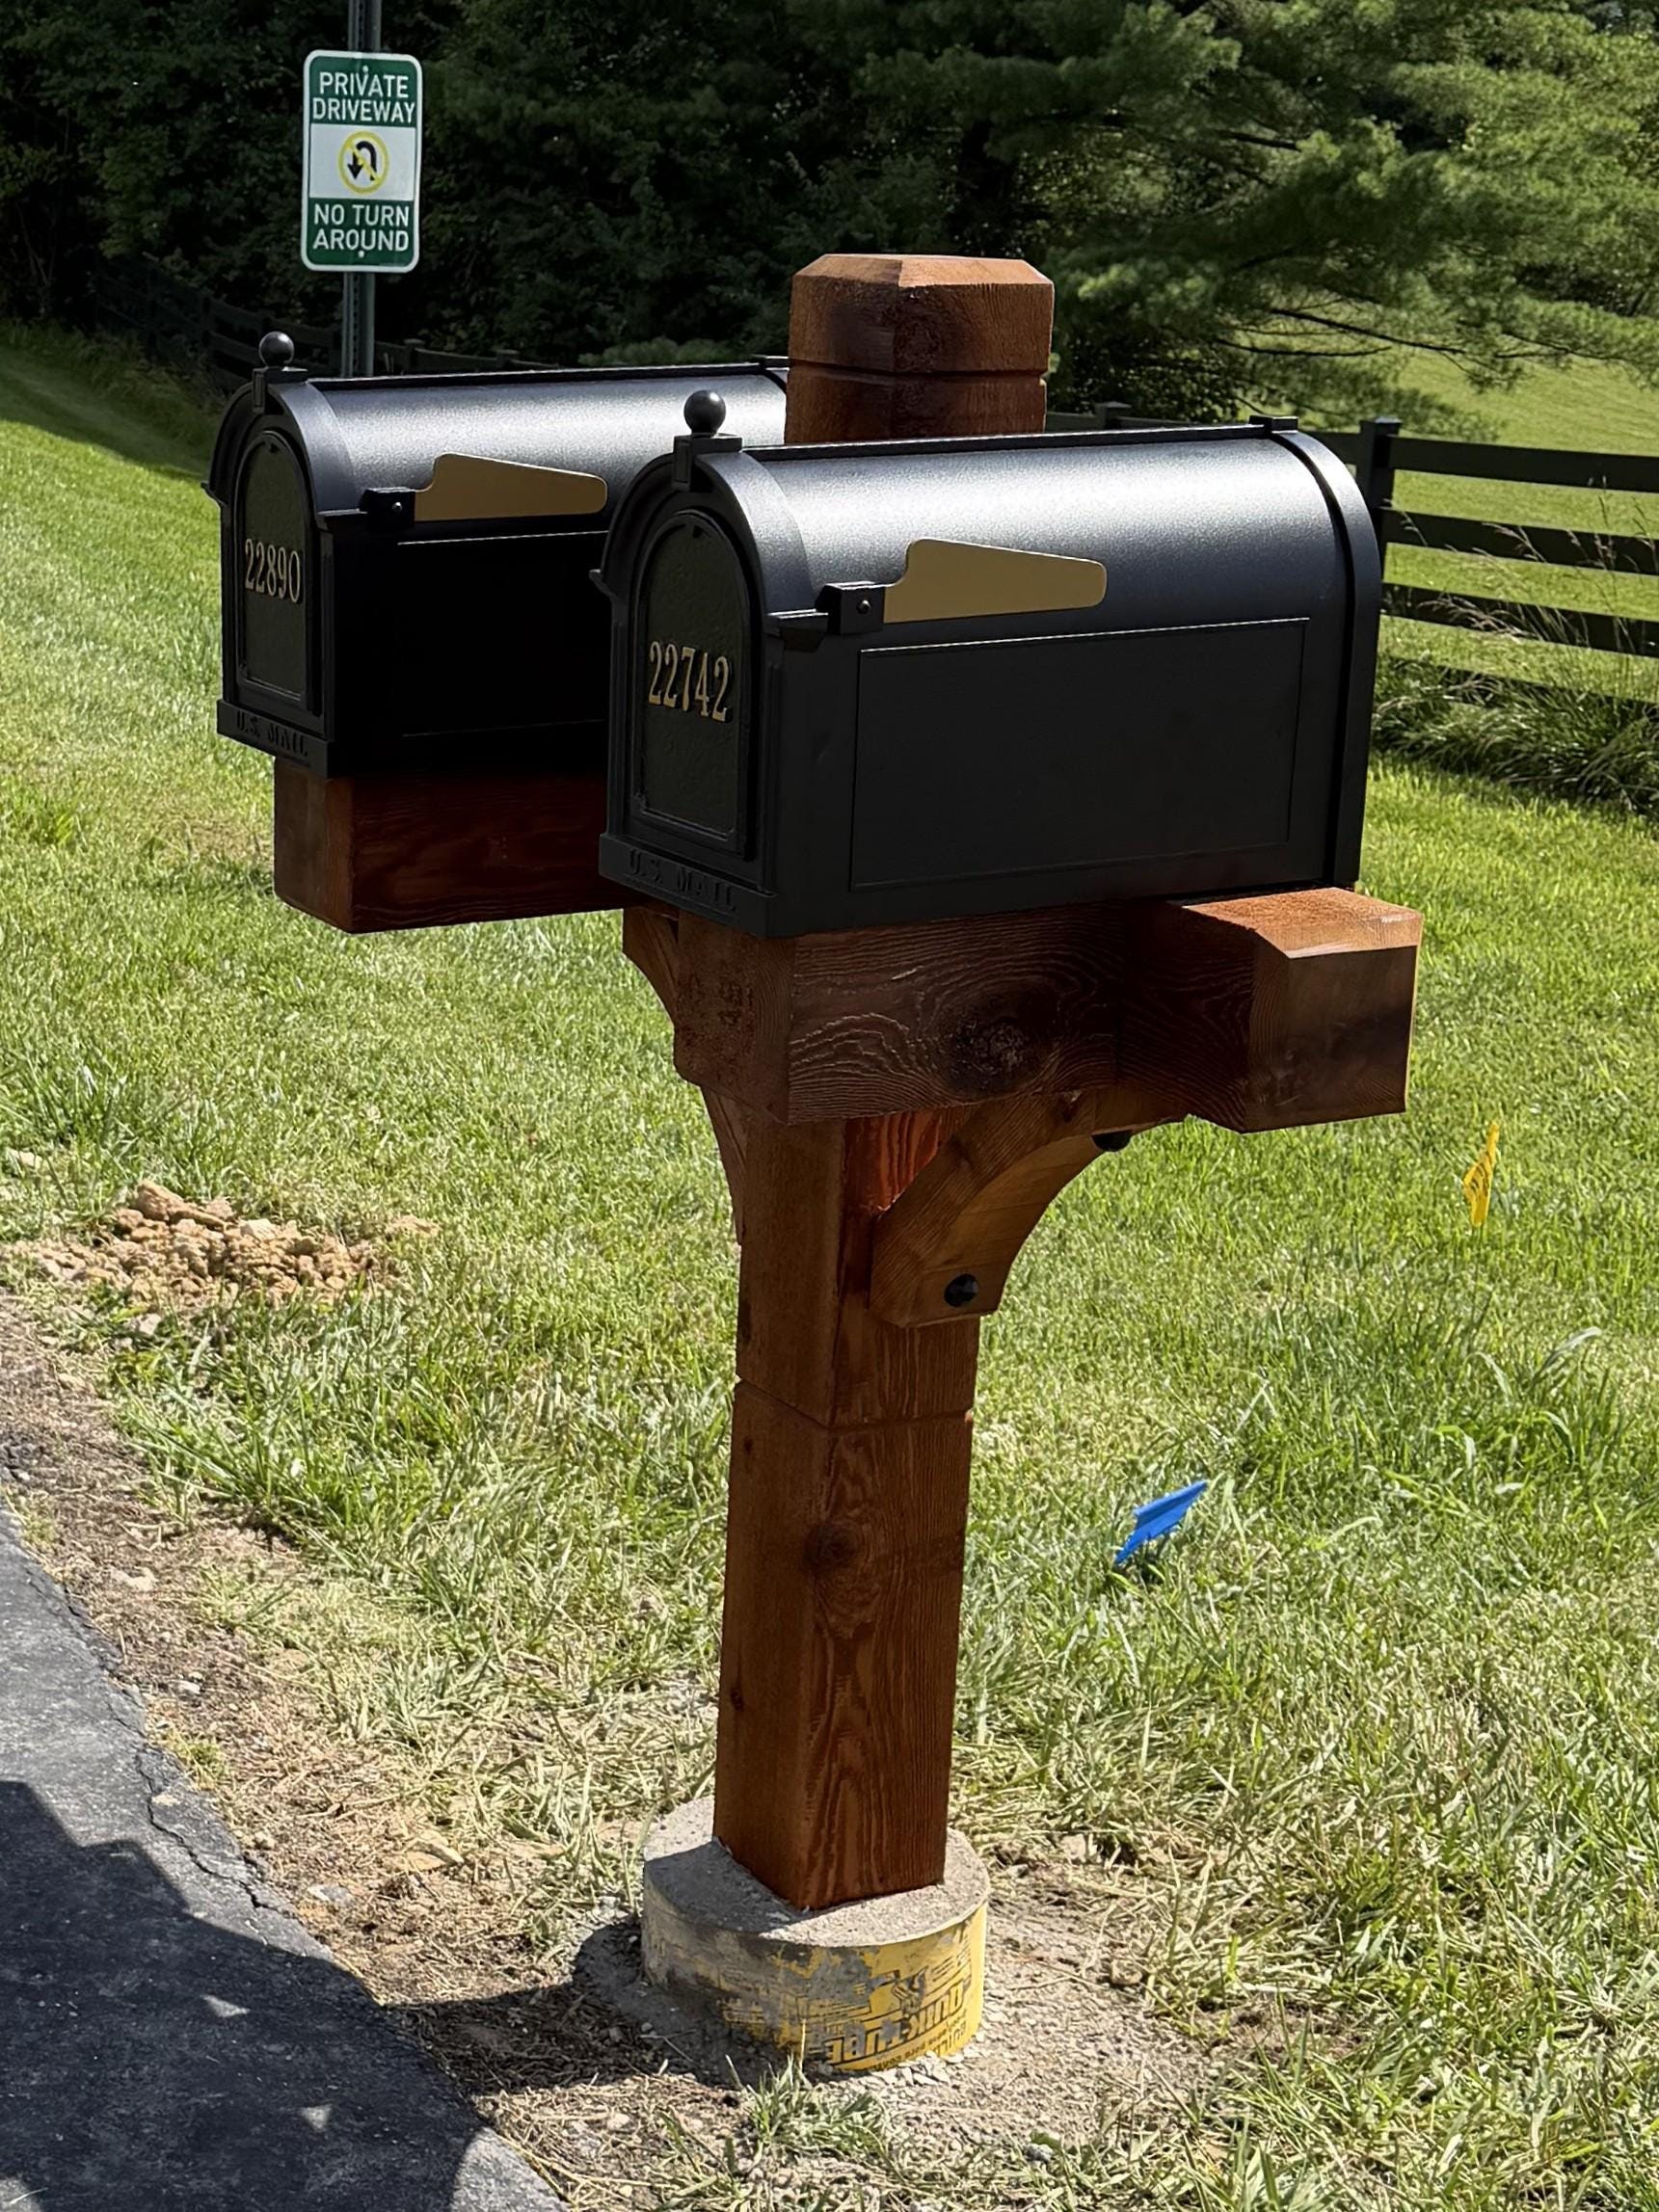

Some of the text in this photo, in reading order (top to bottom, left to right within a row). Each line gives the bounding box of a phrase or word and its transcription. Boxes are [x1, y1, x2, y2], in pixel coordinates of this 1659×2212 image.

[319, 71, 409, 98] PRIVATE
[312, 97, 415, 123] DRIVEWAY
[313, 203, 410, 227] NO TURN
[312, 229, 409, 252] AROUND
[245, 538, 301, 603] 22890
[648, 641, 729, 722] 22742
[267, 722, 308, 757] MAIL
[676, 866, 736, 912] MAIL
